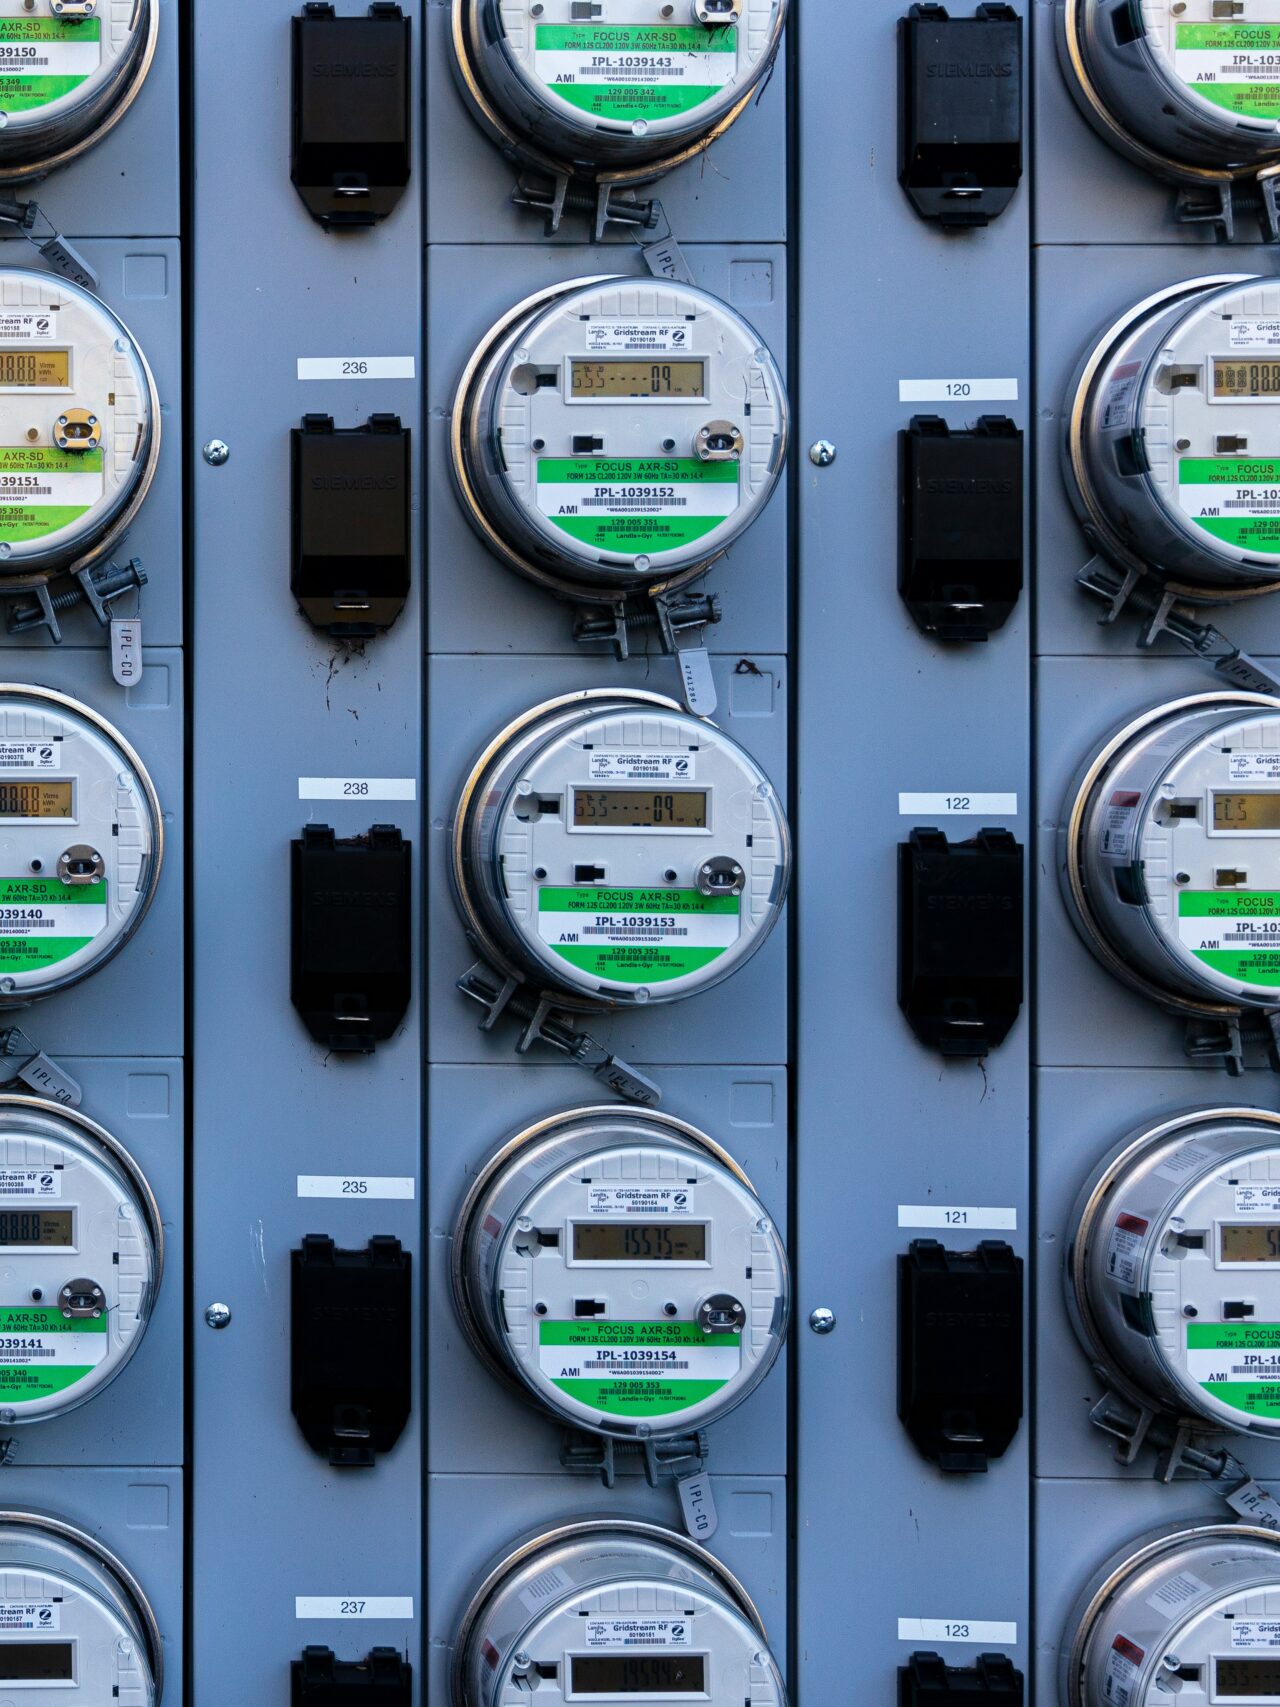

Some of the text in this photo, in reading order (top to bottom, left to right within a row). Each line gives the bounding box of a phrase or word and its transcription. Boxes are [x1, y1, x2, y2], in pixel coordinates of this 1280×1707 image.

[0, 22, 41, 31] AXR-SD
[593, 32, 677, 41] FOCUS AXR-SD
[1234, 30, 1270, 39] FOCUS
[592, 56, 671, 67] IPL-1039143
[312, 62, 398, 78] SIEMENS
[926, 63, 1012, 78] SIEMENS
[555, 74, 575, 82] AMI
[1196, 73, 1216, 81] AMI
[343, 362, 367, 373] 236
[947, 384, 970, 395] 120
[3, 452, 44, 461] AXR-SD
[596, 462, 679, 471] FOCUS AXR-SD
[1237, 464, 1273, 473] FOCUS
[594, 487, 675, 497] IPL-1039152
[558, 506, 578, 514] AMI
[1200, 508, 1220, 516] AMI
[121, 629, 133, 677] IPL-CO
[344, 783, 368, 794] 238
[946, 798, 969, 809] 122
[6, 884, 47, 893] AXR-SD
[597, 892, 680, 902] FOCUS AXR-SD
[1237, 897, 1273, 906] FOCUS
[595, 916, 675, 928] IPL-1039153
[559, 934, 579, 942] AMI
[1200, 940, 1220, 948] AMI
[32, 1068, 71, 1103] IPL-CO
[343, 1181, 367, 1193] 235
[945, 1212, 966, 1223] 121
[7, 1314, 48, 1323] AXR-SD
[598, 1325, 681, 1335] FOCUS AXR-SD
[596, 1350, 676, 1361] IPL-1039154
[561, 1368, 581, 1376] AMI
[689, 1484, 709, 1530] IPL-CO
[341, 1602, 365, 1613] 237
[946, 1625, 969, 1637] 123
